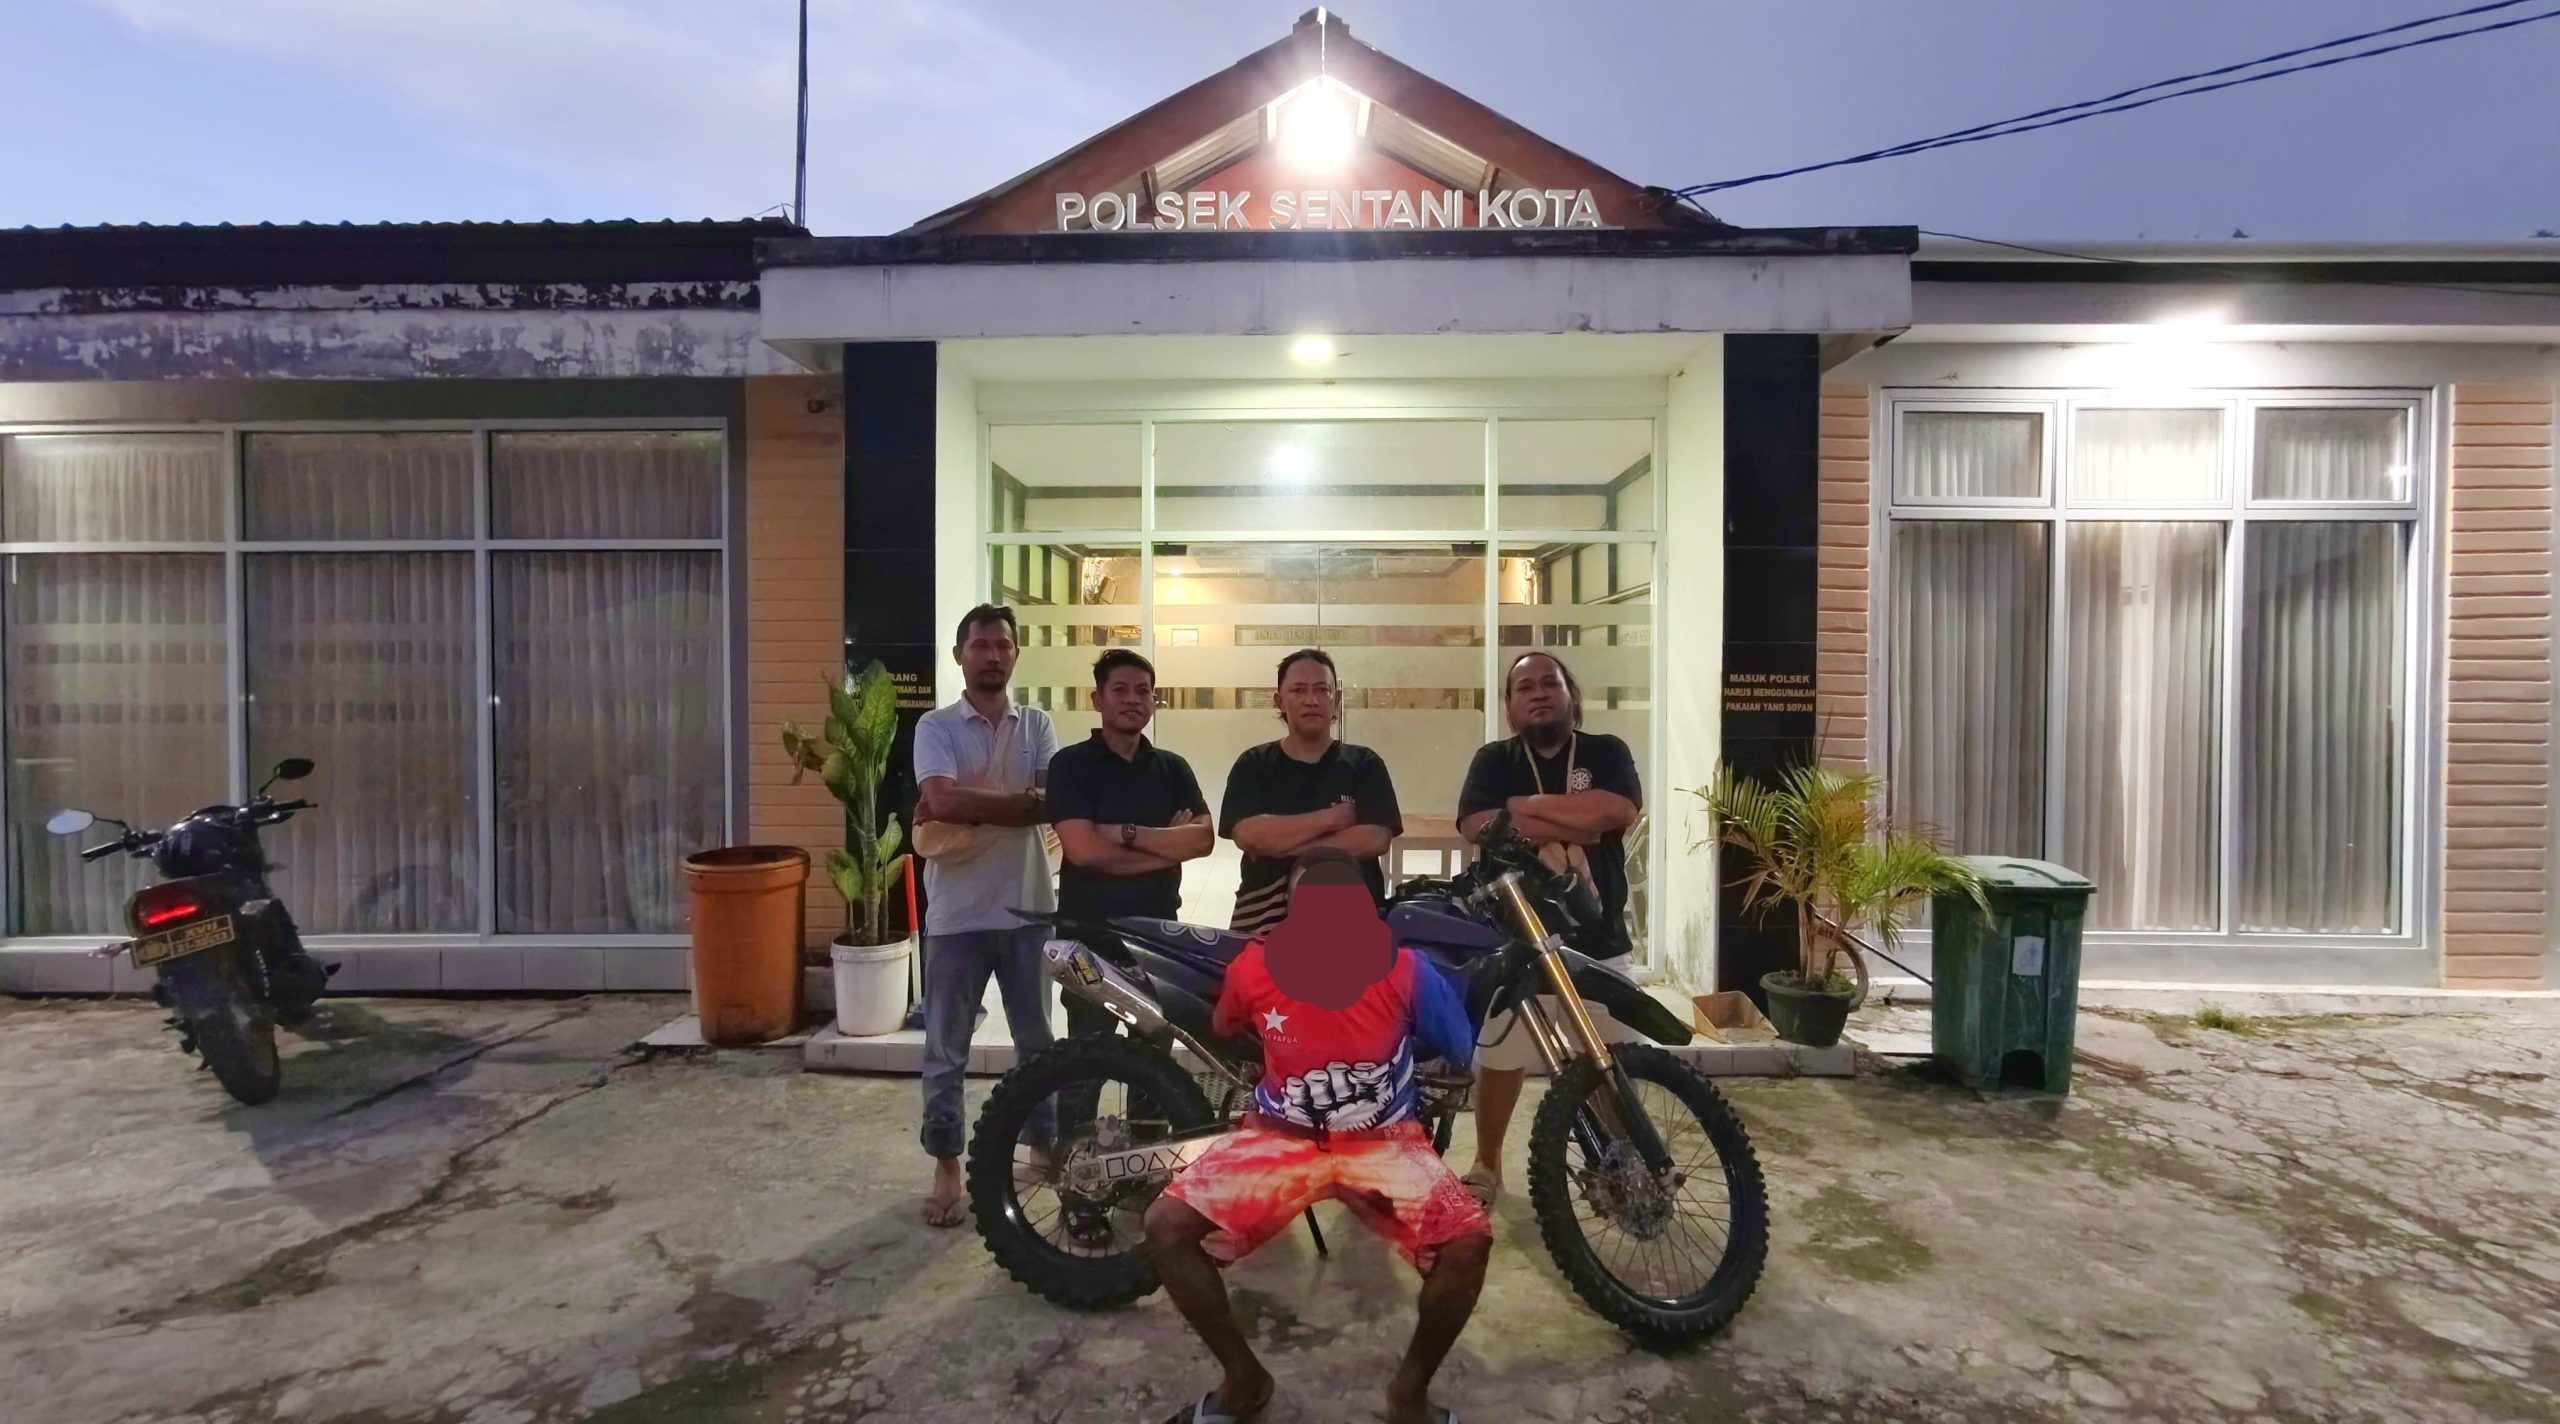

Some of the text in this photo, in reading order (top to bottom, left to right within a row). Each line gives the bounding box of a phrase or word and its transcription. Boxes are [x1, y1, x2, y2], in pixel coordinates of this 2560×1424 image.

[1056, 188, 1600, 231] POLSEK SENTANI KOTA
[890, 673, 918, 682] RANG
[1729, 673, 1810, 683] MASUK POLSEK
[1723, 687, 1752, 697] HARUS
[1762, 702, 1785, 712] YANG
